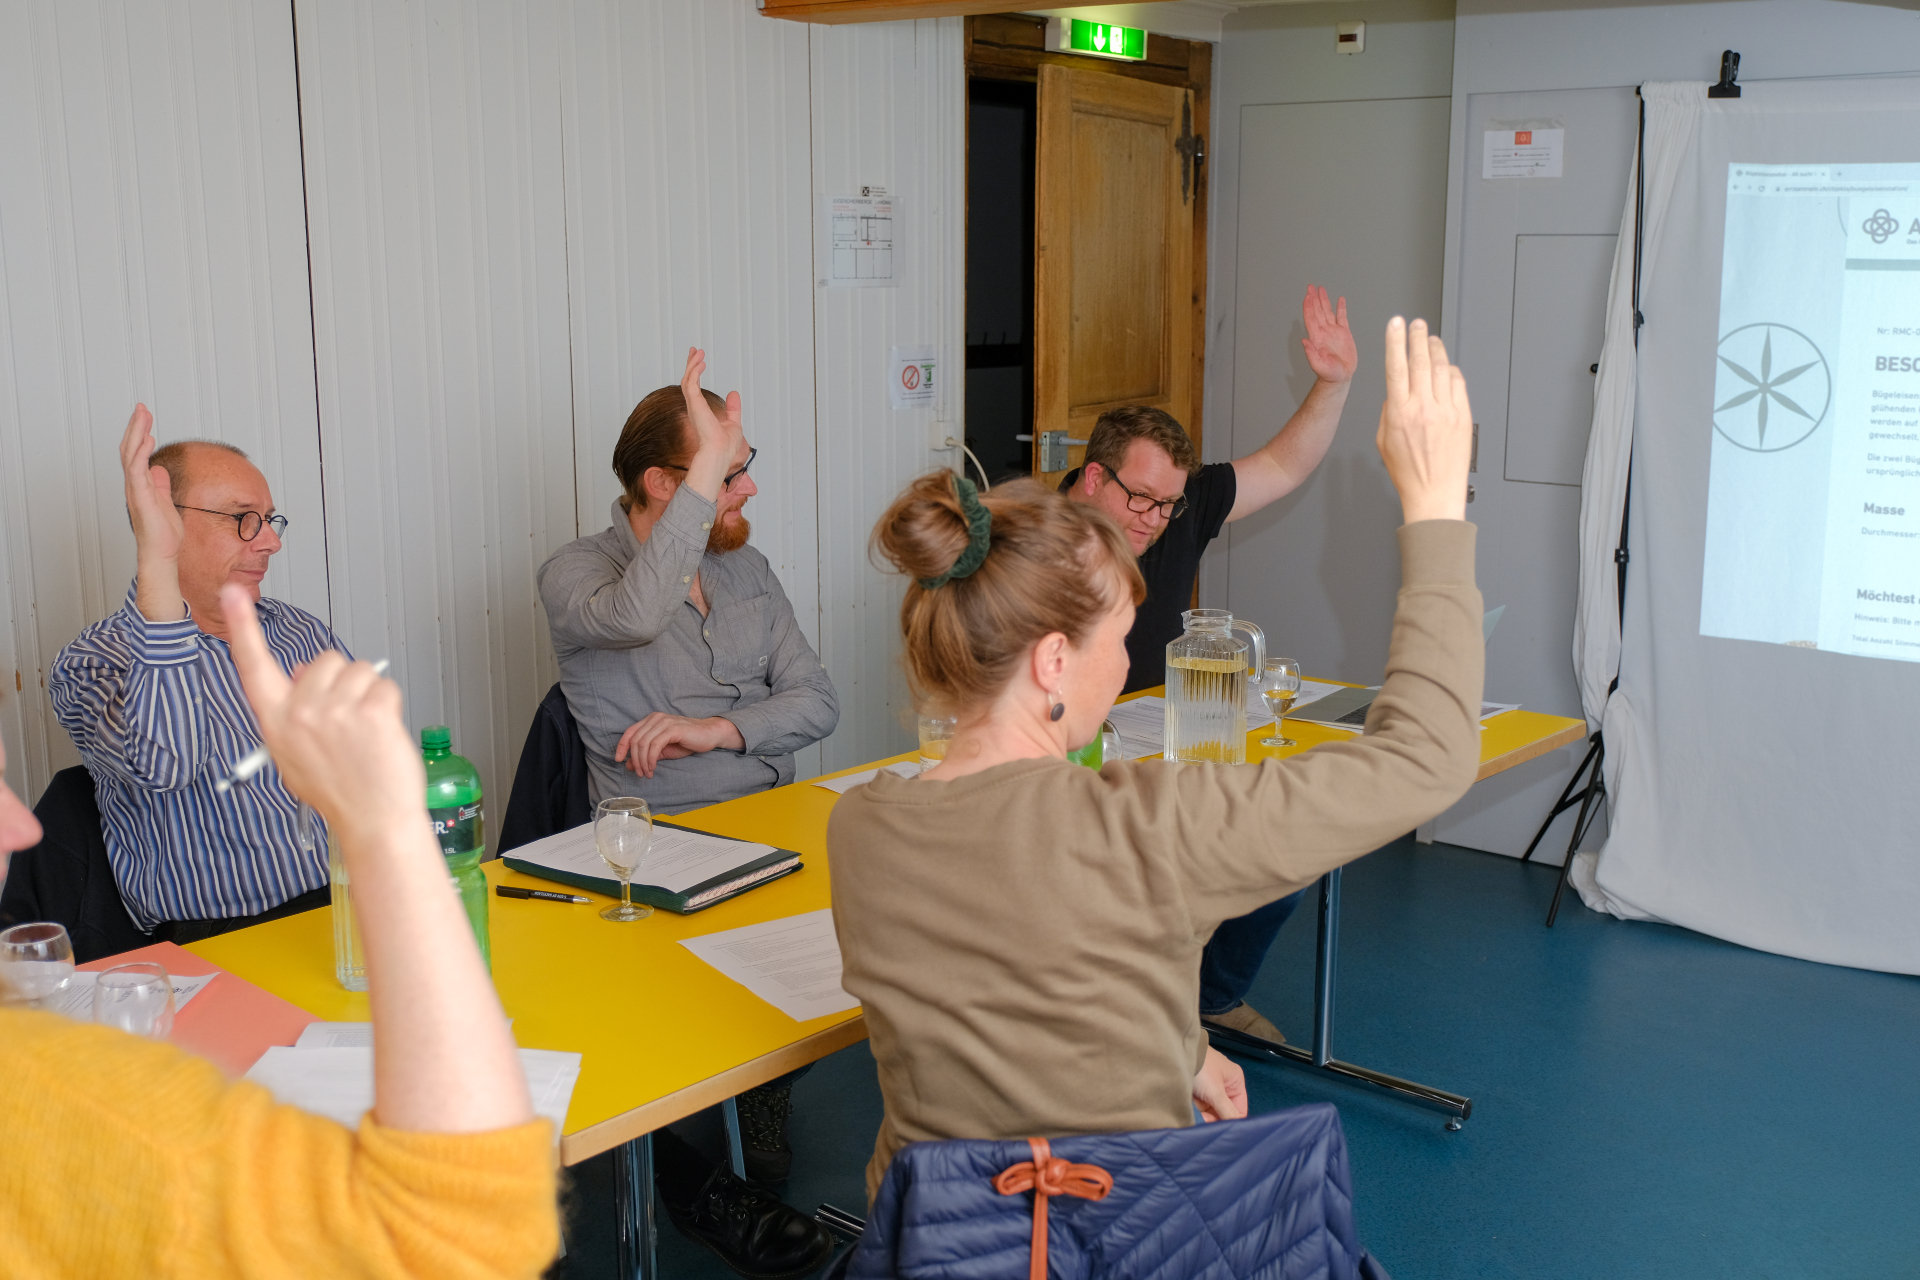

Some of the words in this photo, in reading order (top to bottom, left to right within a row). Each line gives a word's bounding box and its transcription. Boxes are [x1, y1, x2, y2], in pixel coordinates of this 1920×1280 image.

[1907, 217, 1920, 235] A
[1872, 389, 1920, 400] Bügeleisen
[1870, 404, 1916, 413] glühenden
[1870, 418, 1902, 426] werden
[1904, 419, 1918, 427] auf
[1867, 453, 1881, 461] Die
[1883, 455, 1903, 463] zwei
[1863, 502, 1905, 516] Masse
[1857, 588, 1915, 605] Möchtest
[1854, 613, 1890, 623] Hinweis:
[1892, 616, 1912, 626] Bitte
[1869, 637, 1893, 645] Anzahl
